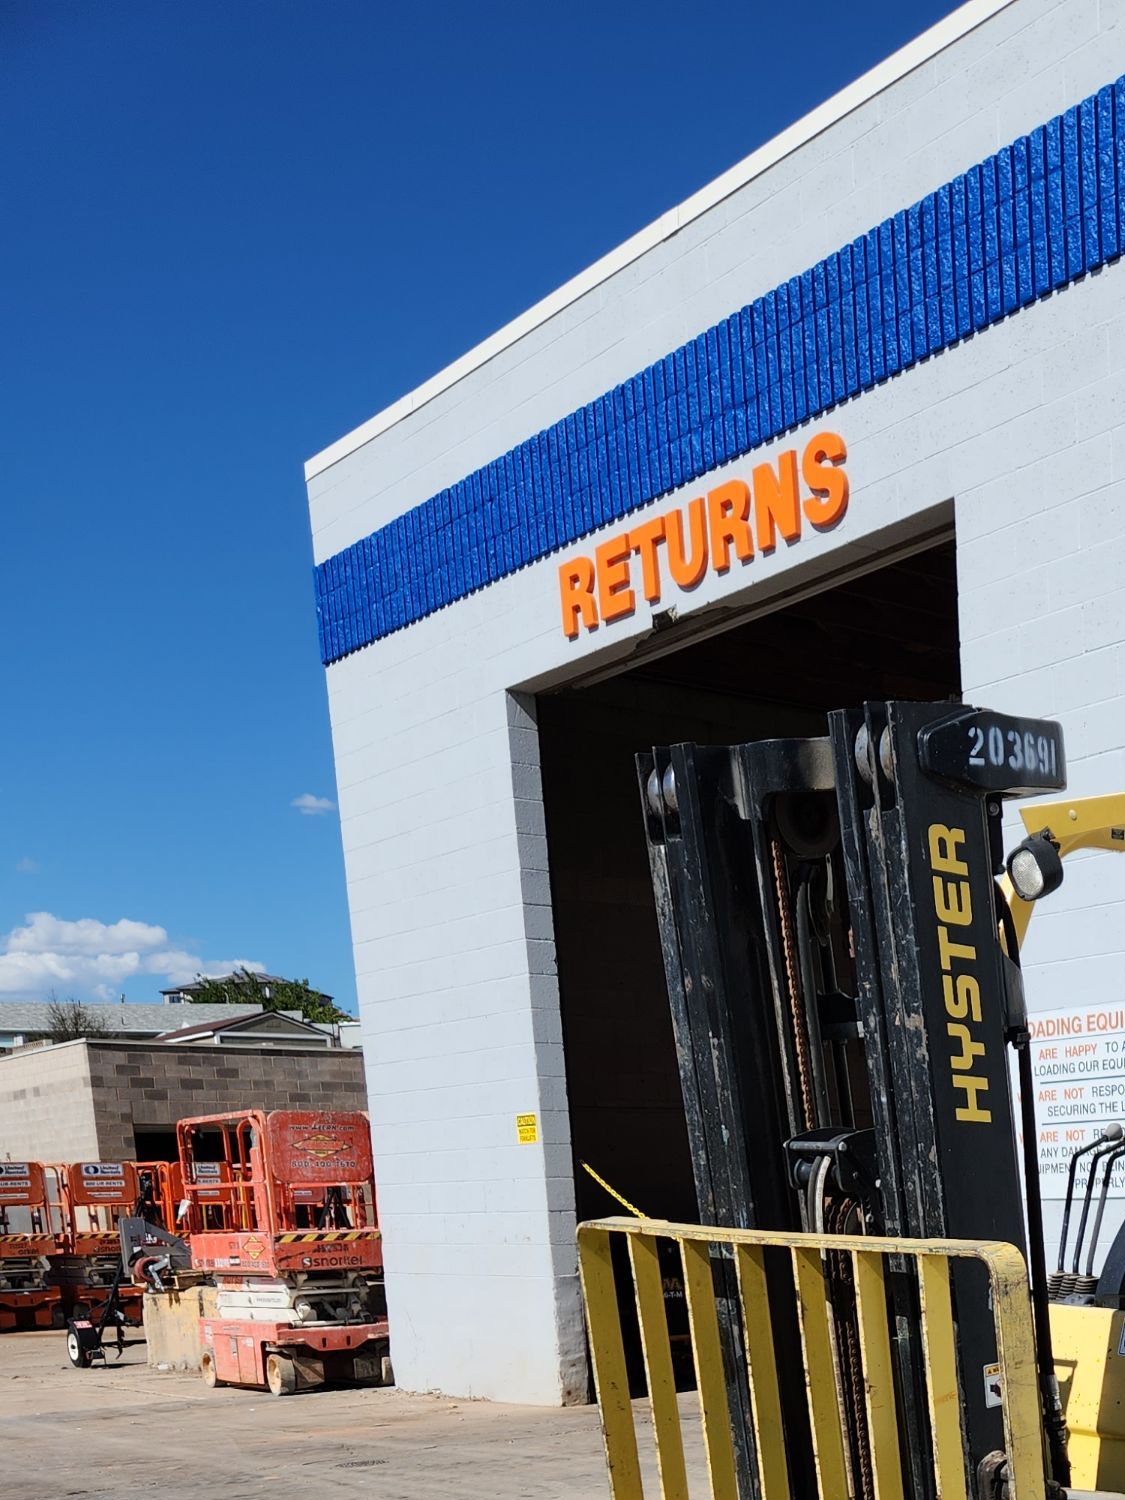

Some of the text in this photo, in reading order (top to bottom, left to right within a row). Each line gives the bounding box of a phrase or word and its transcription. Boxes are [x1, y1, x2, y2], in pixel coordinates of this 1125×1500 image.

[558, 432, 849, 640] RETURNS
[967, 726, 1057, 777] 203691
[928, 823, 992, 1123] HYSTER
[1027, 1015, 1082, 1038] OADING
[1039, 1048, 1058, 1060] ARE
[1065, 1043, 1097, 1058] HAPPY
[1105, 1041, 1119, 1053] TO
[1034, 1062, 1076, 1077] LOADING
[1078, 1060, 1099, 1073] OUR
[1038, 1089, 1057, 1102] ARE
[1064, 1087, 1084, 1100] NOT
[1048, 1103, 1096, 1117] SECURING
[1099, 1101, 1118, 1113] THE
[1040, 1131, 1058, 1143] ARE
[1066, 1129, 1085, 1141] NOT
[1040, 1146, 1058, 1158] ANY
[1080, 1162, 1092, 1173] NO
